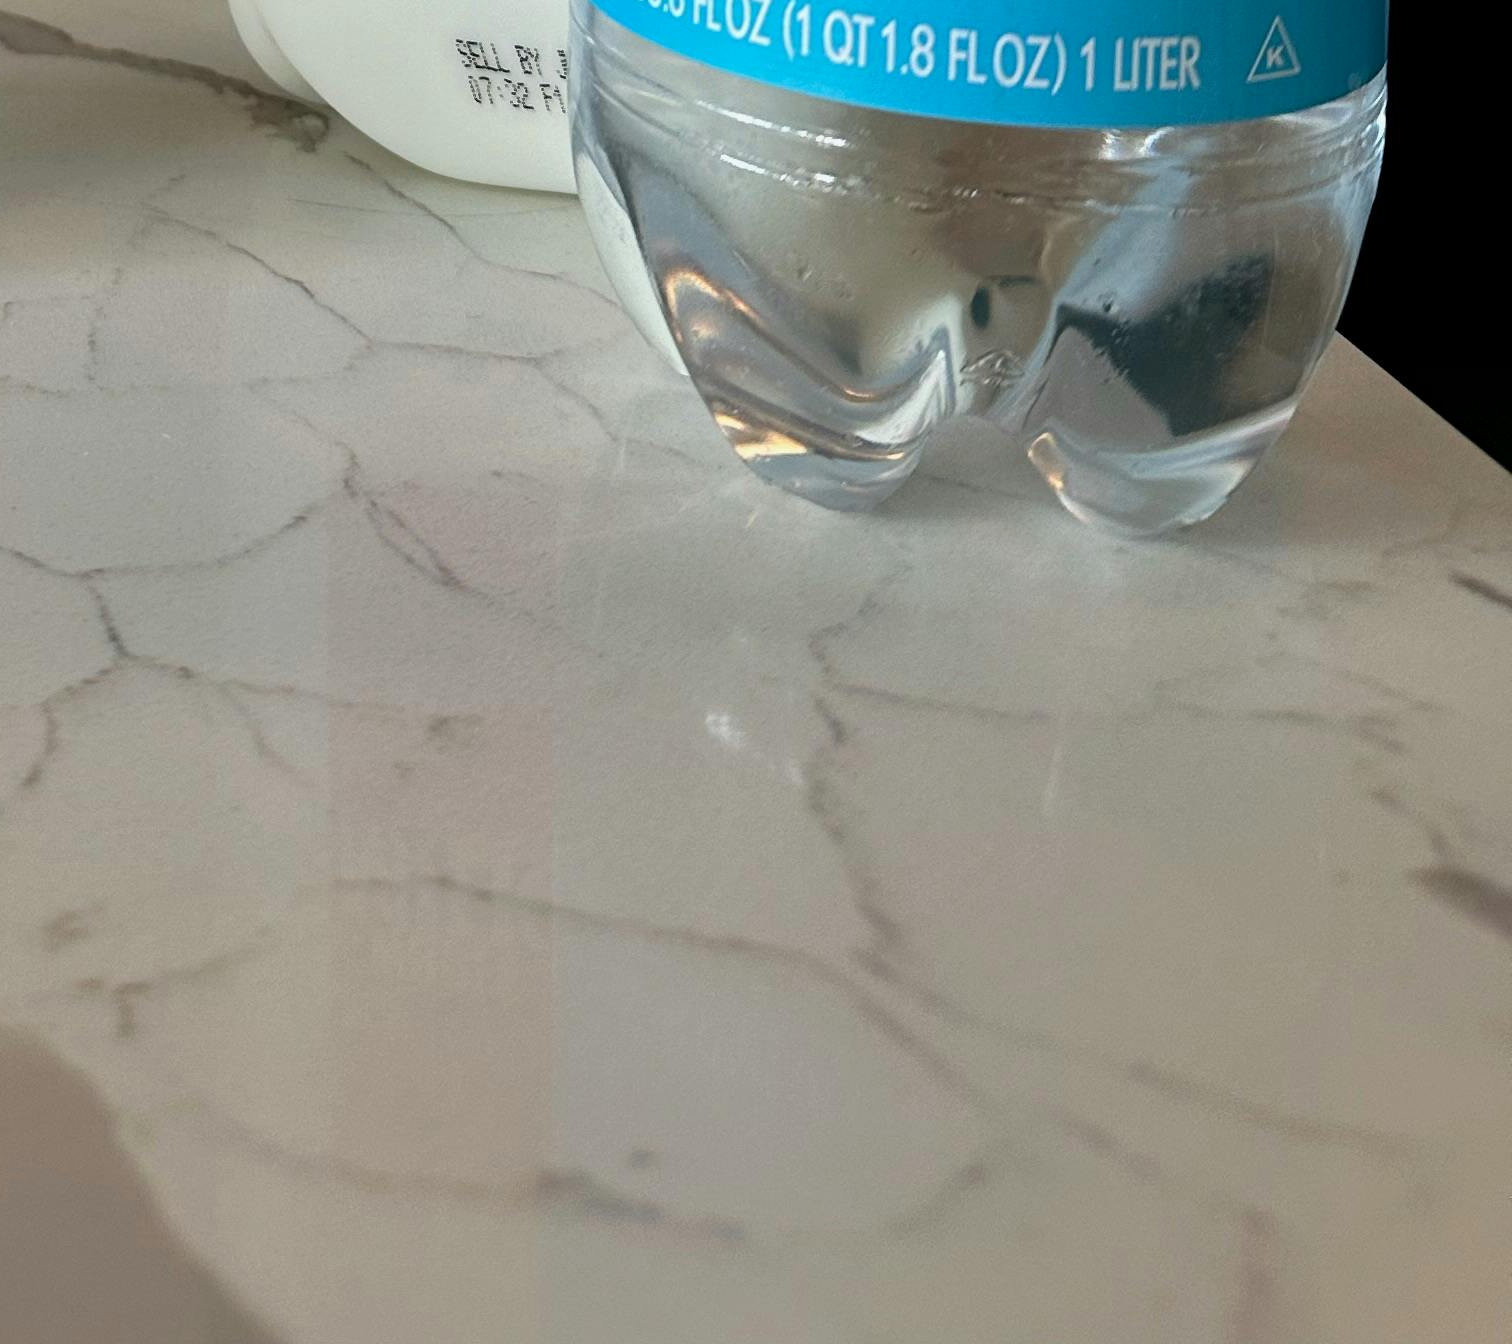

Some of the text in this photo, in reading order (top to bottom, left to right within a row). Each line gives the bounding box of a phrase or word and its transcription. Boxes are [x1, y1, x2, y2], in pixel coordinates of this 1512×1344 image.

[455, 38, 510, 73] SELL
[514, 44, 543, 77] BY
[823, 9, 876, 68] QT
[880, 18, 936, 78] 1.8
[947, 27, 988, 84] FL
[992, 32, 1067, 95] OZ)
[1079, 35, 1096, 92] 1
[1113, 35, 1202, 92] LITER
